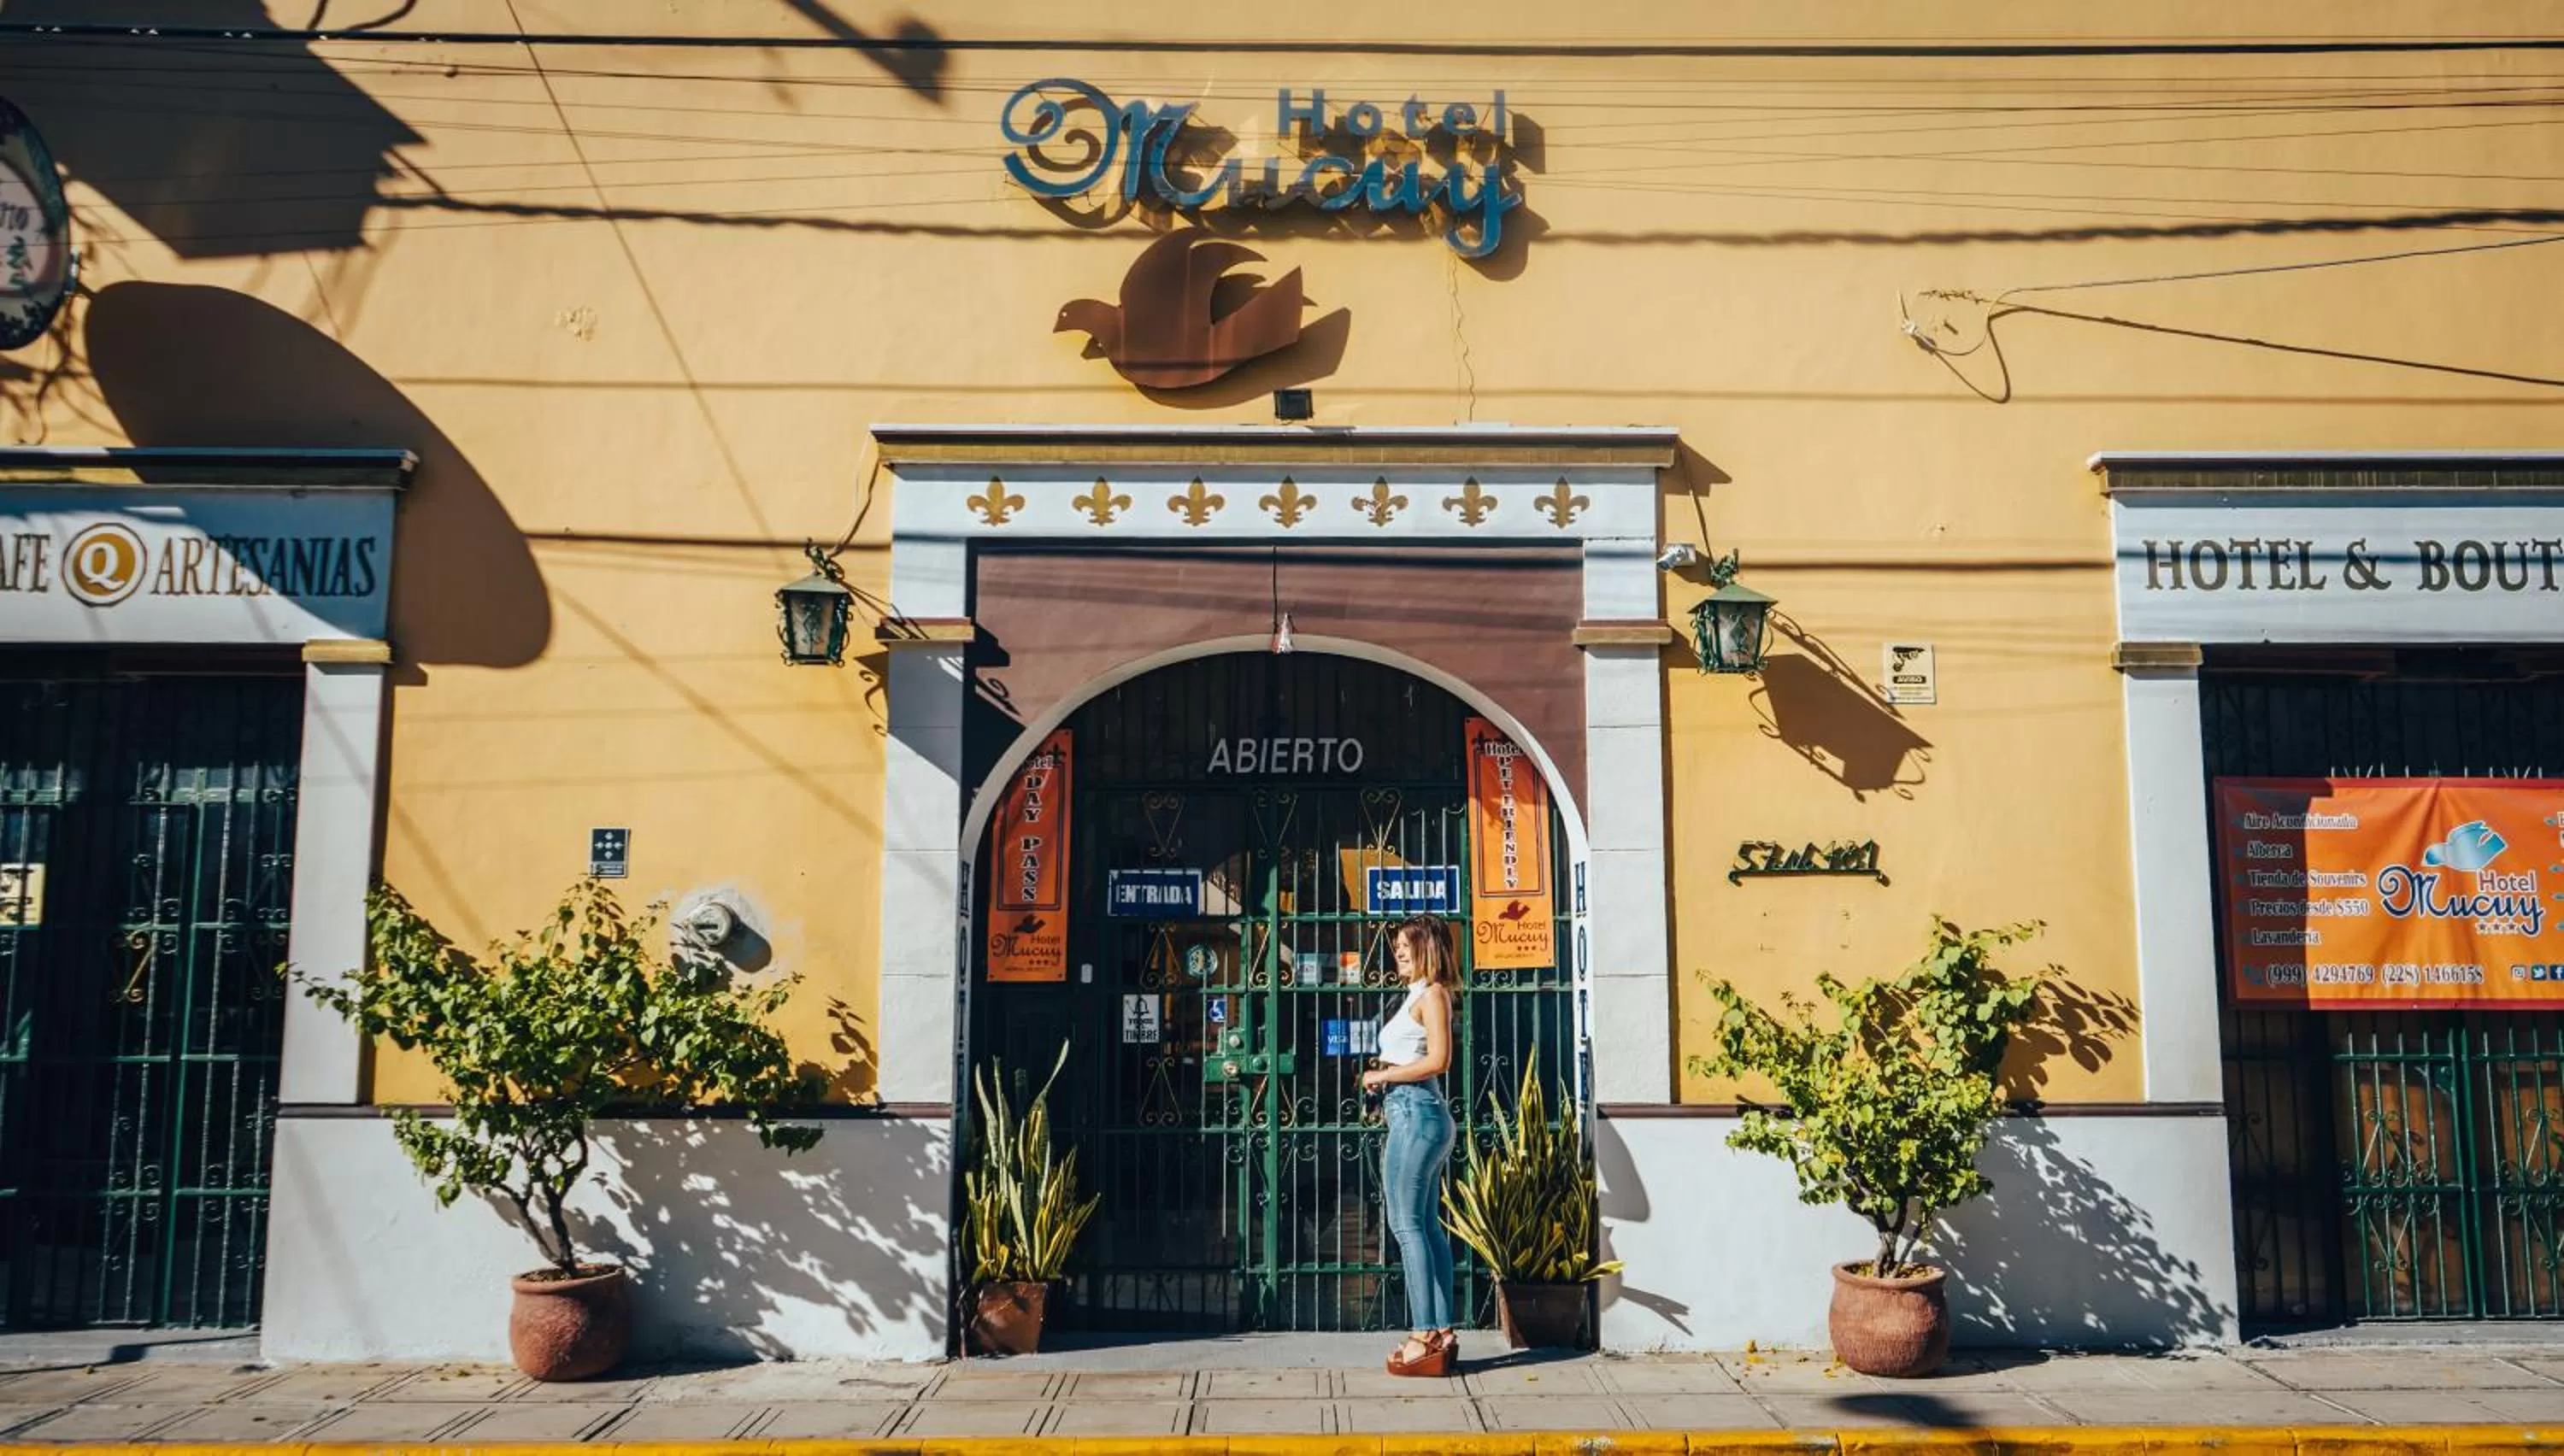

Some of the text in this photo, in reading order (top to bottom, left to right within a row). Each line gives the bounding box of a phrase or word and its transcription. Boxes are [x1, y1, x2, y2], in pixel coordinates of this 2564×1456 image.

[1279, 89, 1504, 138] Hotel
[1001, 78, 1522, 257] Mucuy
[150, 536, 377, 597] ARTESANIAS
[2143, 537, 2564, 591] HOTEL & BOUT
[1207, 737, 1363, 773] ABIERTO
[1020, 775, 1043, 901] DAY PASS
[2248, 841, 2293, 858] Alberca
[1377, 880, 1446, 900] SALIDA
[2249, 870, 2289, 886] Tienda
[2290, 870, 2306, 886] de
[2479, 871, 2537, 891] Hotel
[1115, 884, 1193, 904] ENTRADA
[2378, 865, 2544, 936] Mucuy
[2251, 899, 2369, 917] Precios desde $550
[1477, 921, 1548, 951] Mucuy
[1517, 921, 1546, 931] Hotel
[991, 933, 1061, 966] Mucuy
[1031, 936, 1061, 944] Hotel
[2267, 965, 2306, 985] (999)
[2314, 965, 2374, 983] 4294769
